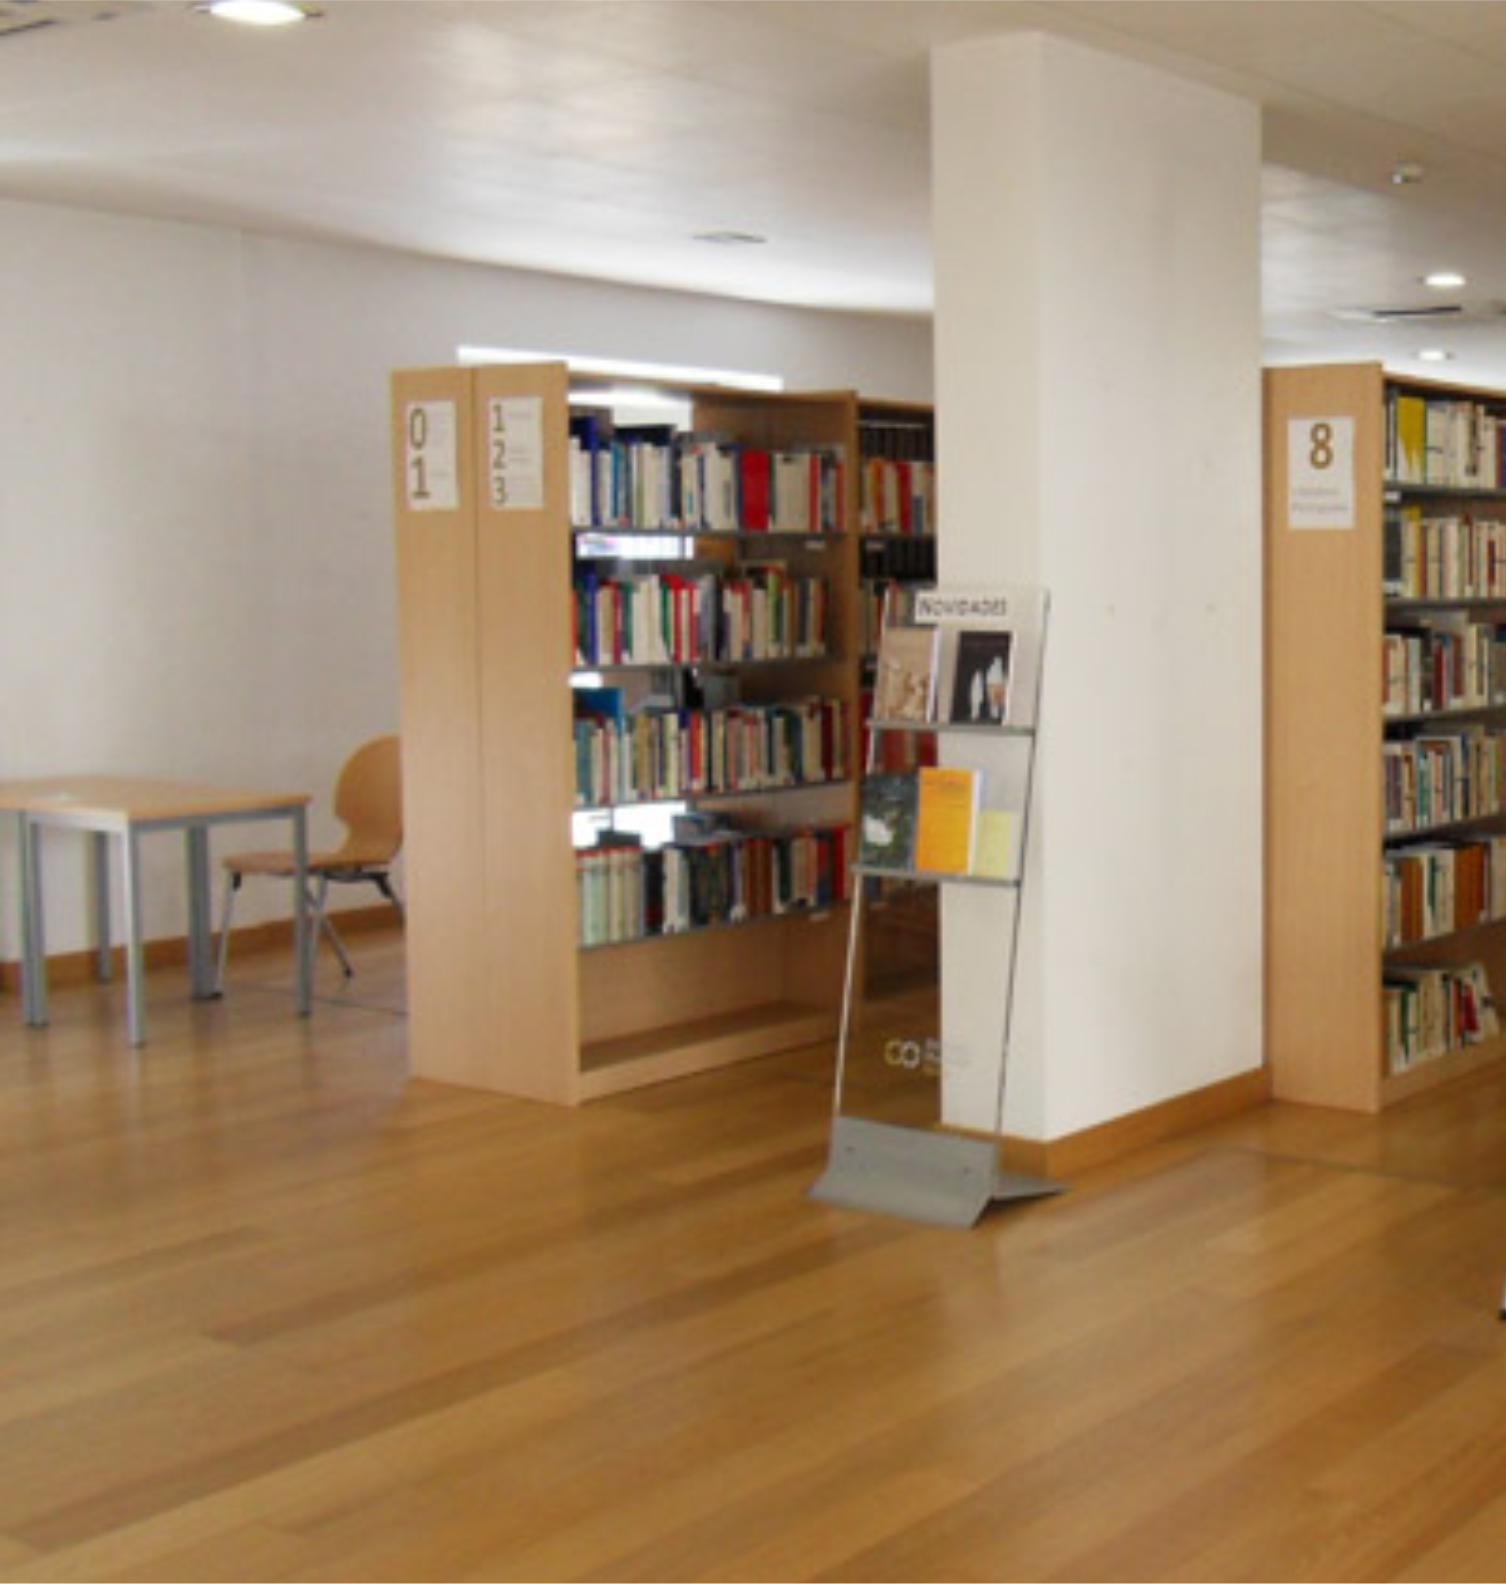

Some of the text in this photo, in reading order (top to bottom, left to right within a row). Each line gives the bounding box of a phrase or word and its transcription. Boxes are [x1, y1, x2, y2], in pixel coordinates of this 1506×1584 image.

[410, 407, 426, 450] 0
[493, 404, 505, 432] 1
[493, 439, 506, 469] 2
[1310, 422, 1333, 470] 8
[411, 457, 430, 498] 1
[493, 476, 508, 506] 3
